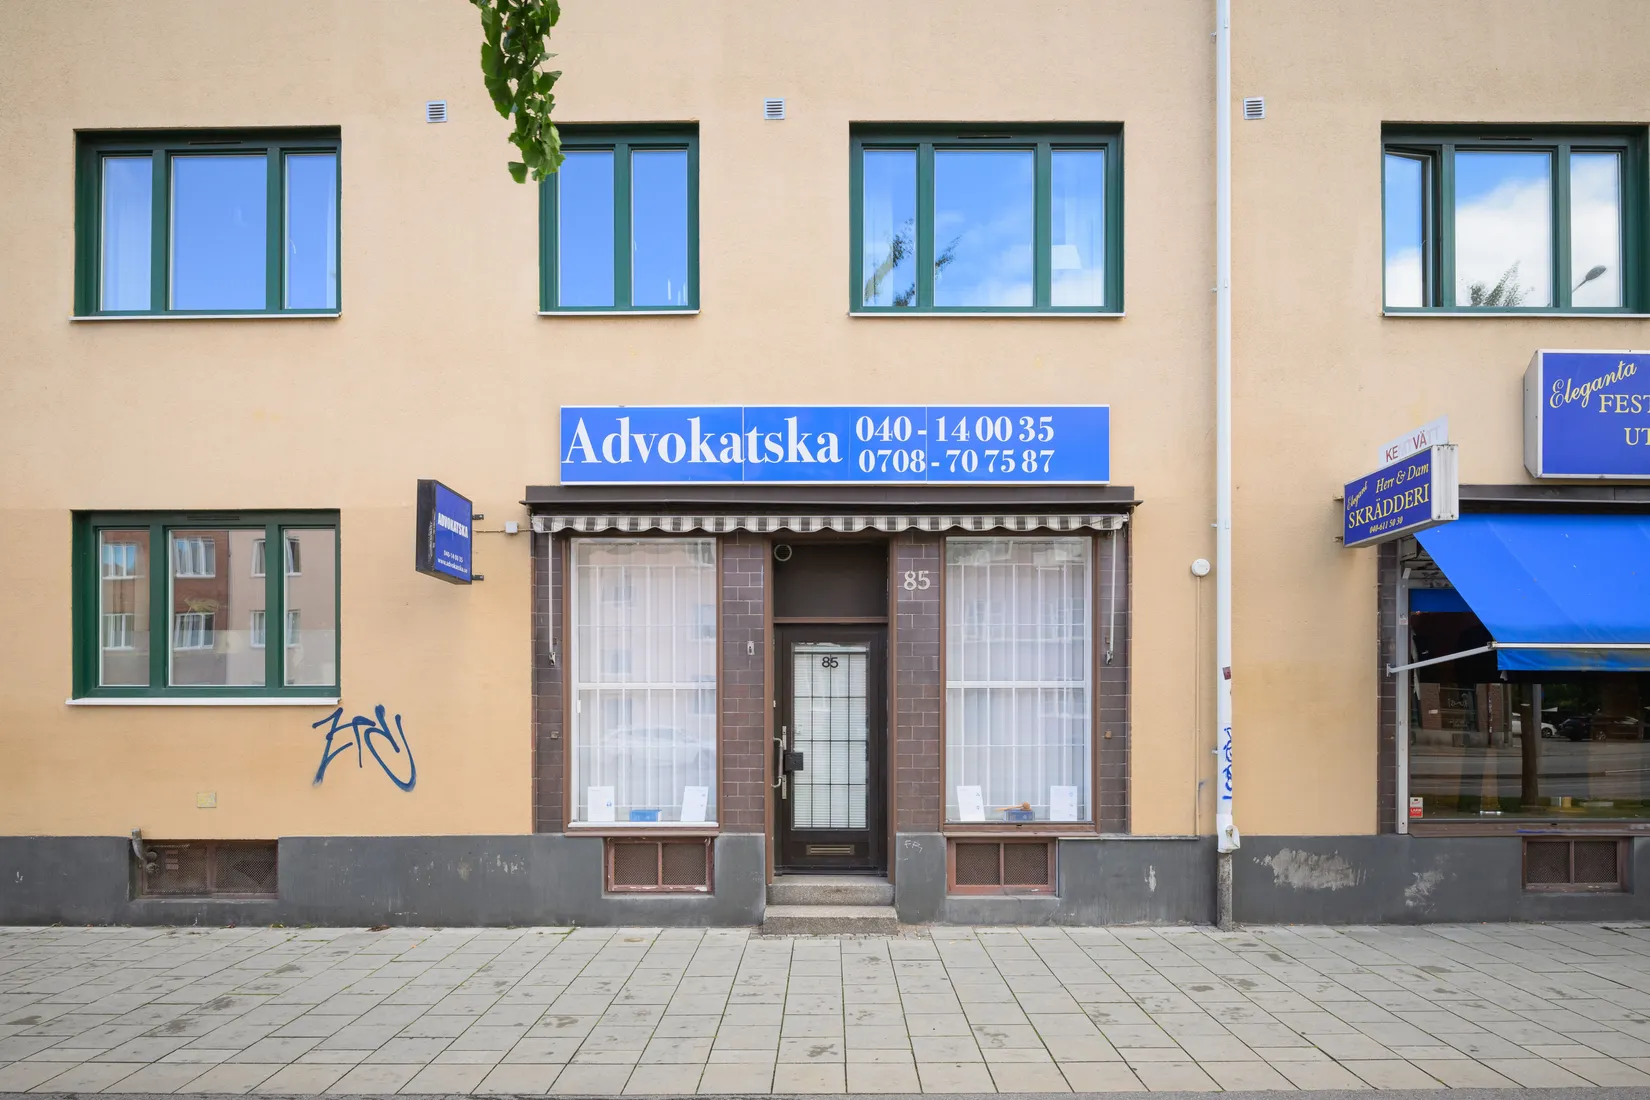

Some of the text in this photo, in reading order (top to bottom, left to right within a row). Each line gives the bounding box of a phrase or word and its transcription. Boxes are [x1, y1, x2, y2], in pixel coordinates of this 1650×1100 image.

[1549, 360, 1638, 409] Eleganta
[561, 415, 844, 464] Advokatska
[975, 415, 1013, 442] 00
[1018, 415, 1055, 442] 35
[984, 448, 1016, 473] 75
[1021, 448, 1055, 473] 87
[1375, 477, 1395, 494] Herr
[1396, 470, 1406, 485] &
[1407, 463, 1429, 481] Dam
[1348, 483, 1430, 529] SKRÄDDERI
[437, 512, 469, 539] ADVOKATSKA
[903, 570, 931, 591] 85
[821, 656, 839, 668] 85
